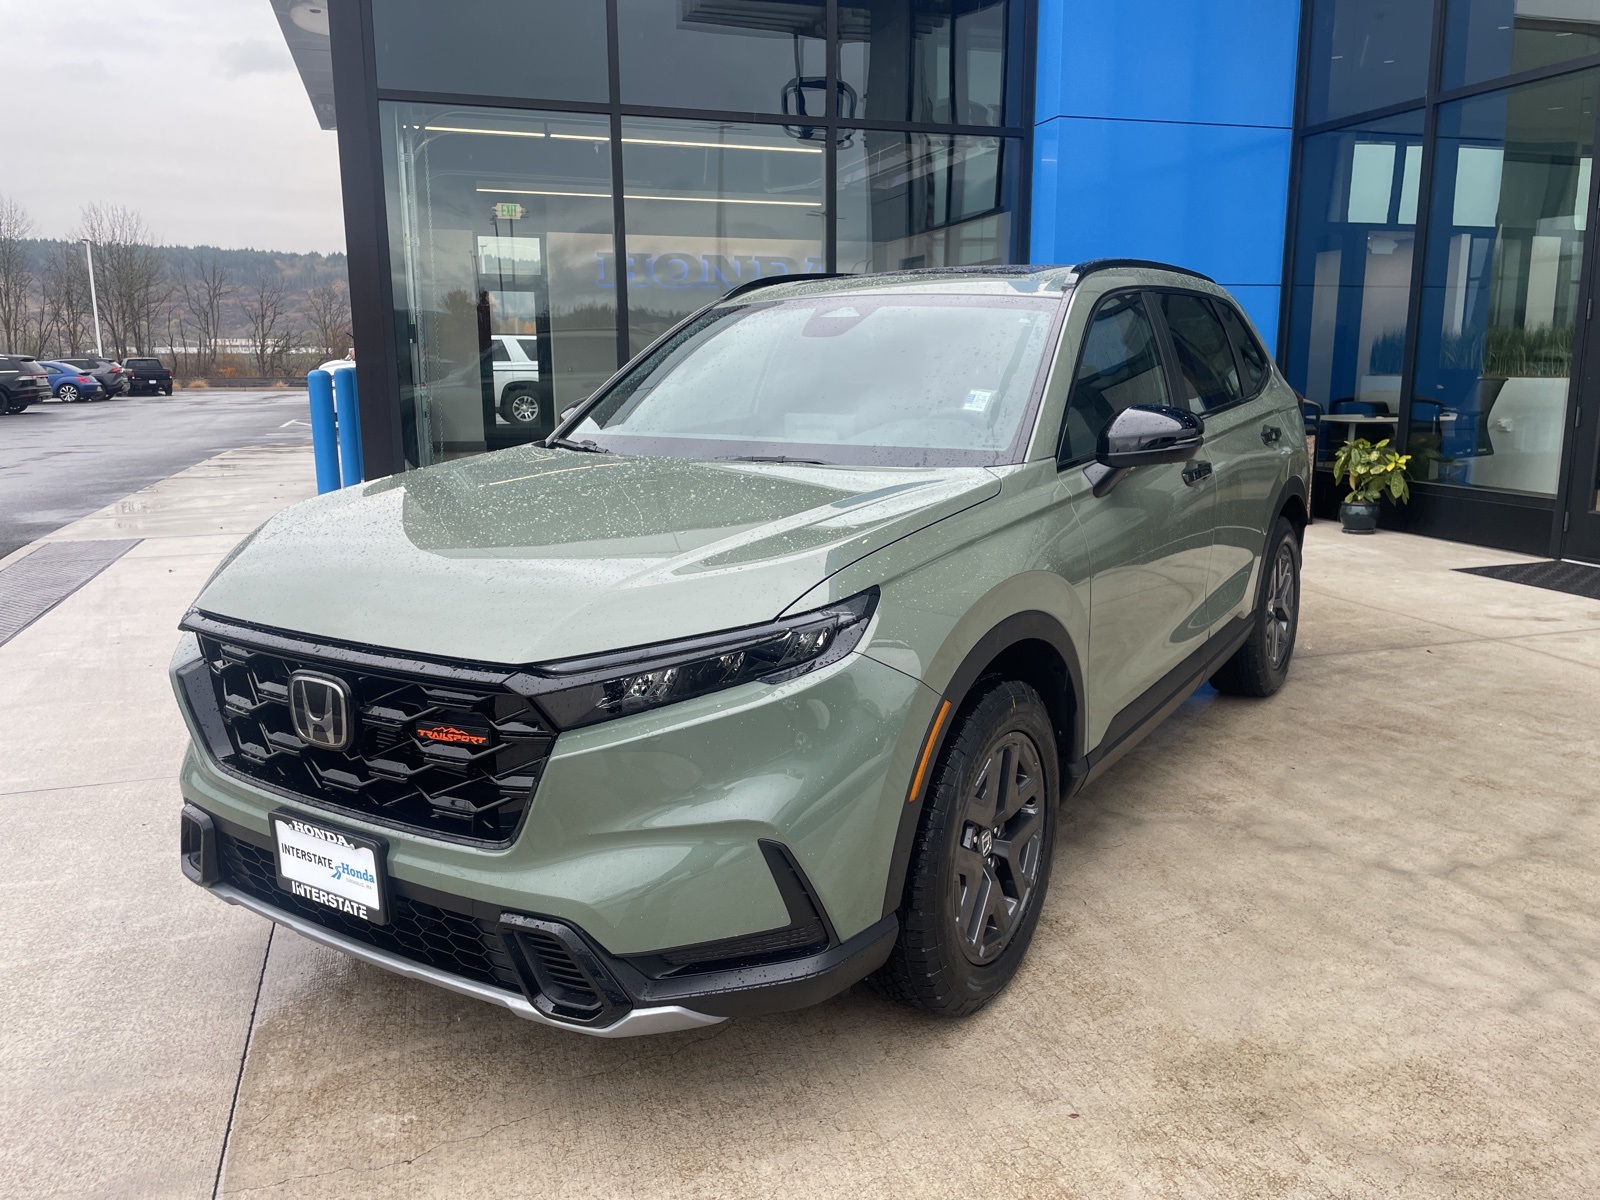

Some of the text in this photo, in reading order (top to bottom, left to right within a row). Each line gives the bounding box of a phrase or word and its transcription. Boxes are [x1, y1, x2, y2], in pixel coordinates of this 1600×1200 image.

[501, 204, 517, 217] EXIT
[417, 729, 487, 745] TRAILSPORT
[292, 821, 350, 847] HONDA
[281, 842, 375, 884] INTERSTATE Honda
[291, 880, 368, 920] INTERSTATE
